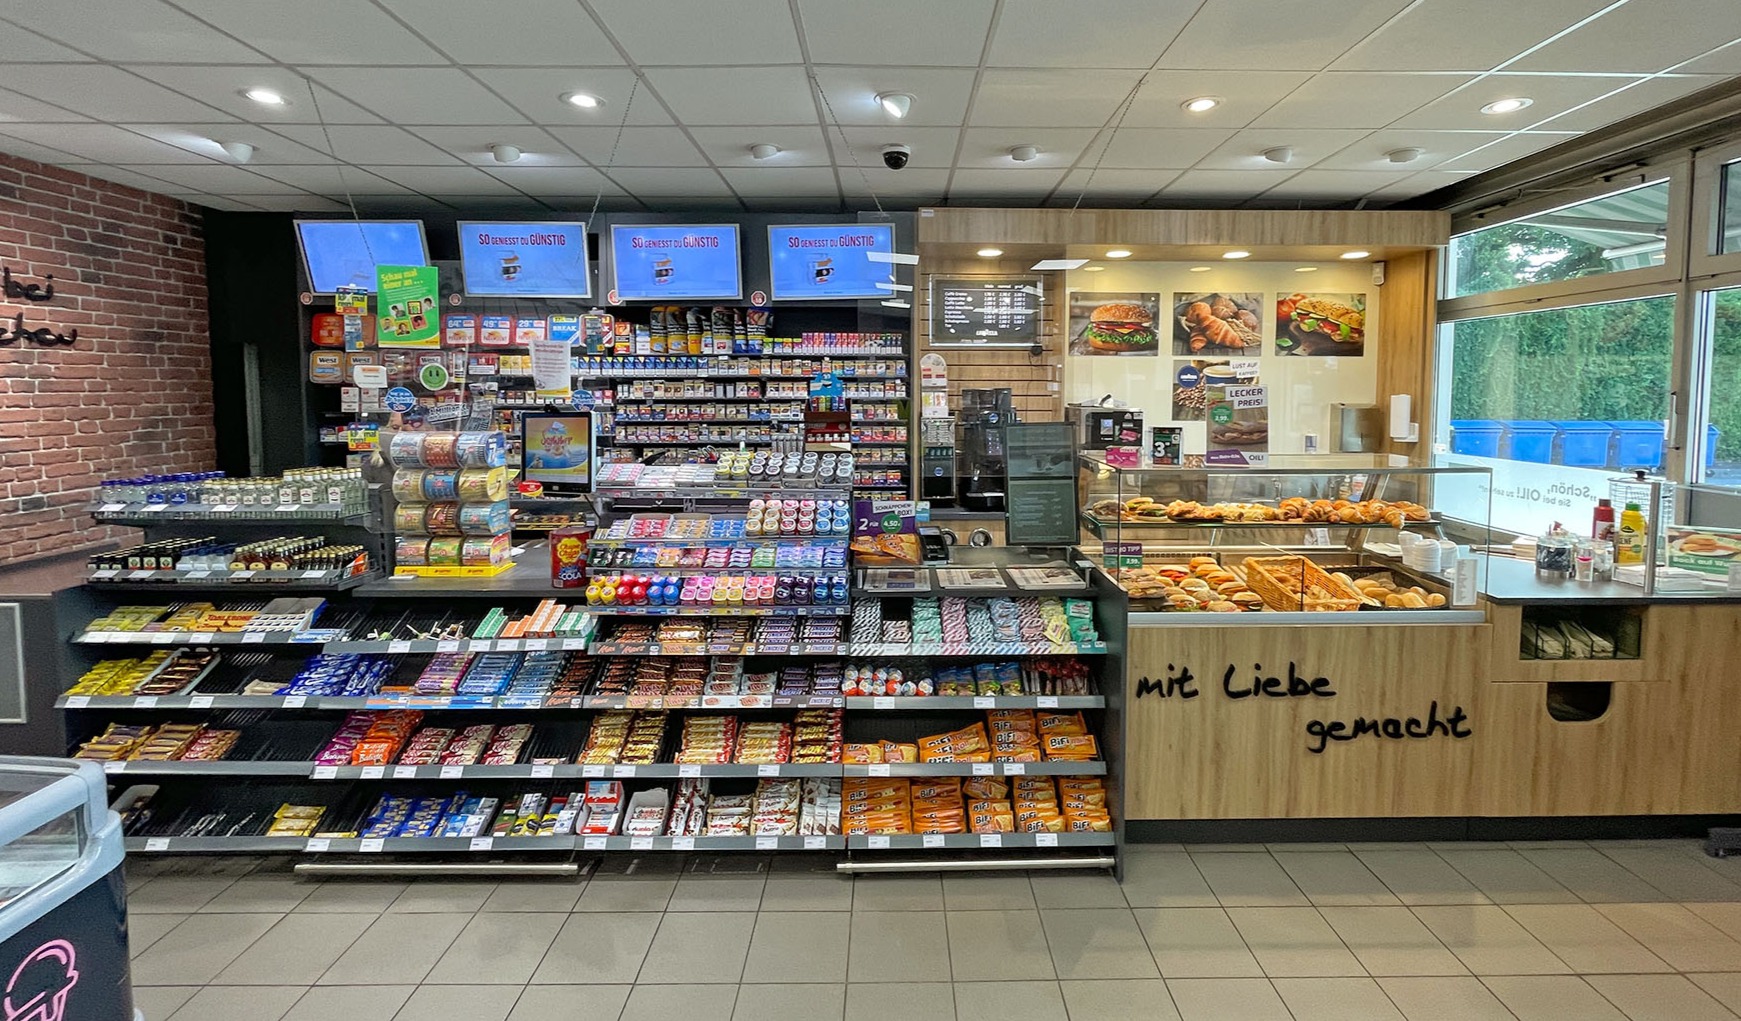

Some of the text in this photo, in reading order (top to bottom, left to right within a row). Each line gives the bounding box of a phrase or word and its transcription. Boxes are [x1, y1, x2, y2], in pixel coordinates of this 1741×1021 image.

[479, 233, 566, 245] SO GENIESST DU GÜNSTIG
[632, 234, 718, 248] SO GENIESST DU GÜNSTIG
[788, 234, 874, 248] SO GENIESST DU GÜNSTIG
[1230, 388, 1263, 398] LECKER
[1238, 399, 1263, 407] PREIS!
[858, 518, 868, 530] 2
[1136, 662, 1336, 700] mit Liebe
[993, 722, 1012, 730] BiFi
[1042, 718, 1060, 728] BiFi
[1306, 701, 1472, 754] gemacht
[996, 733, 1016, 742] BiFi
[1050, 738, 1070, 747] BiFi
[850, 790, 866, 801] BiFi
[920, 788, 936, 798] BiFi
[976, 816, 992, 824] BiFi
[1073, 820, 1090, 830] BiFi
[1027, 822, 1044, 832] BiFi
